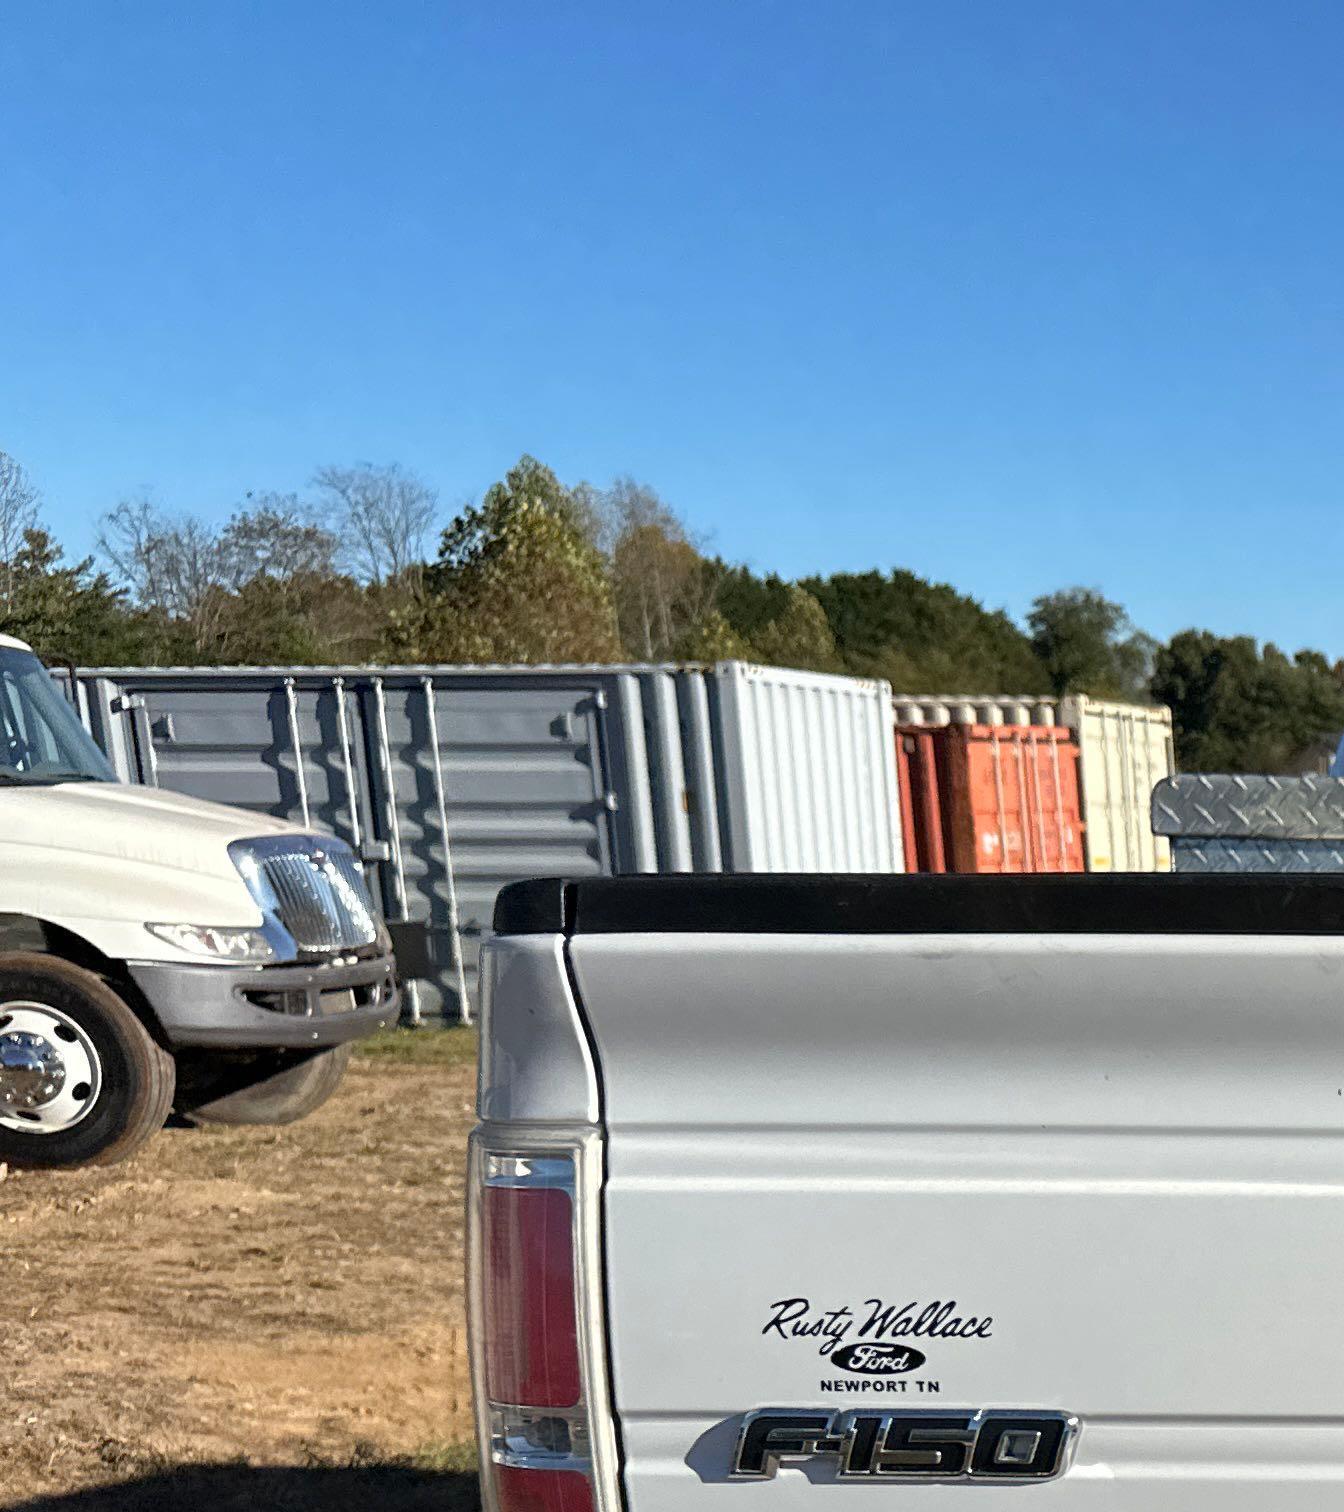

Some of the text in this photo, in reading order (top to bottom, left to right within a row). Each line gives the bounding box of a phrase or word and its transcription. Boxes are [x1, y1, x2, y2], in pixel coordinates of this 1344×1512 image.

[761, 1298, 993, 1355] Rusty Wallace
[848, 1342, 910, 1372] Ford
[820, 1379, 941, 1393] NEWPORT TN
